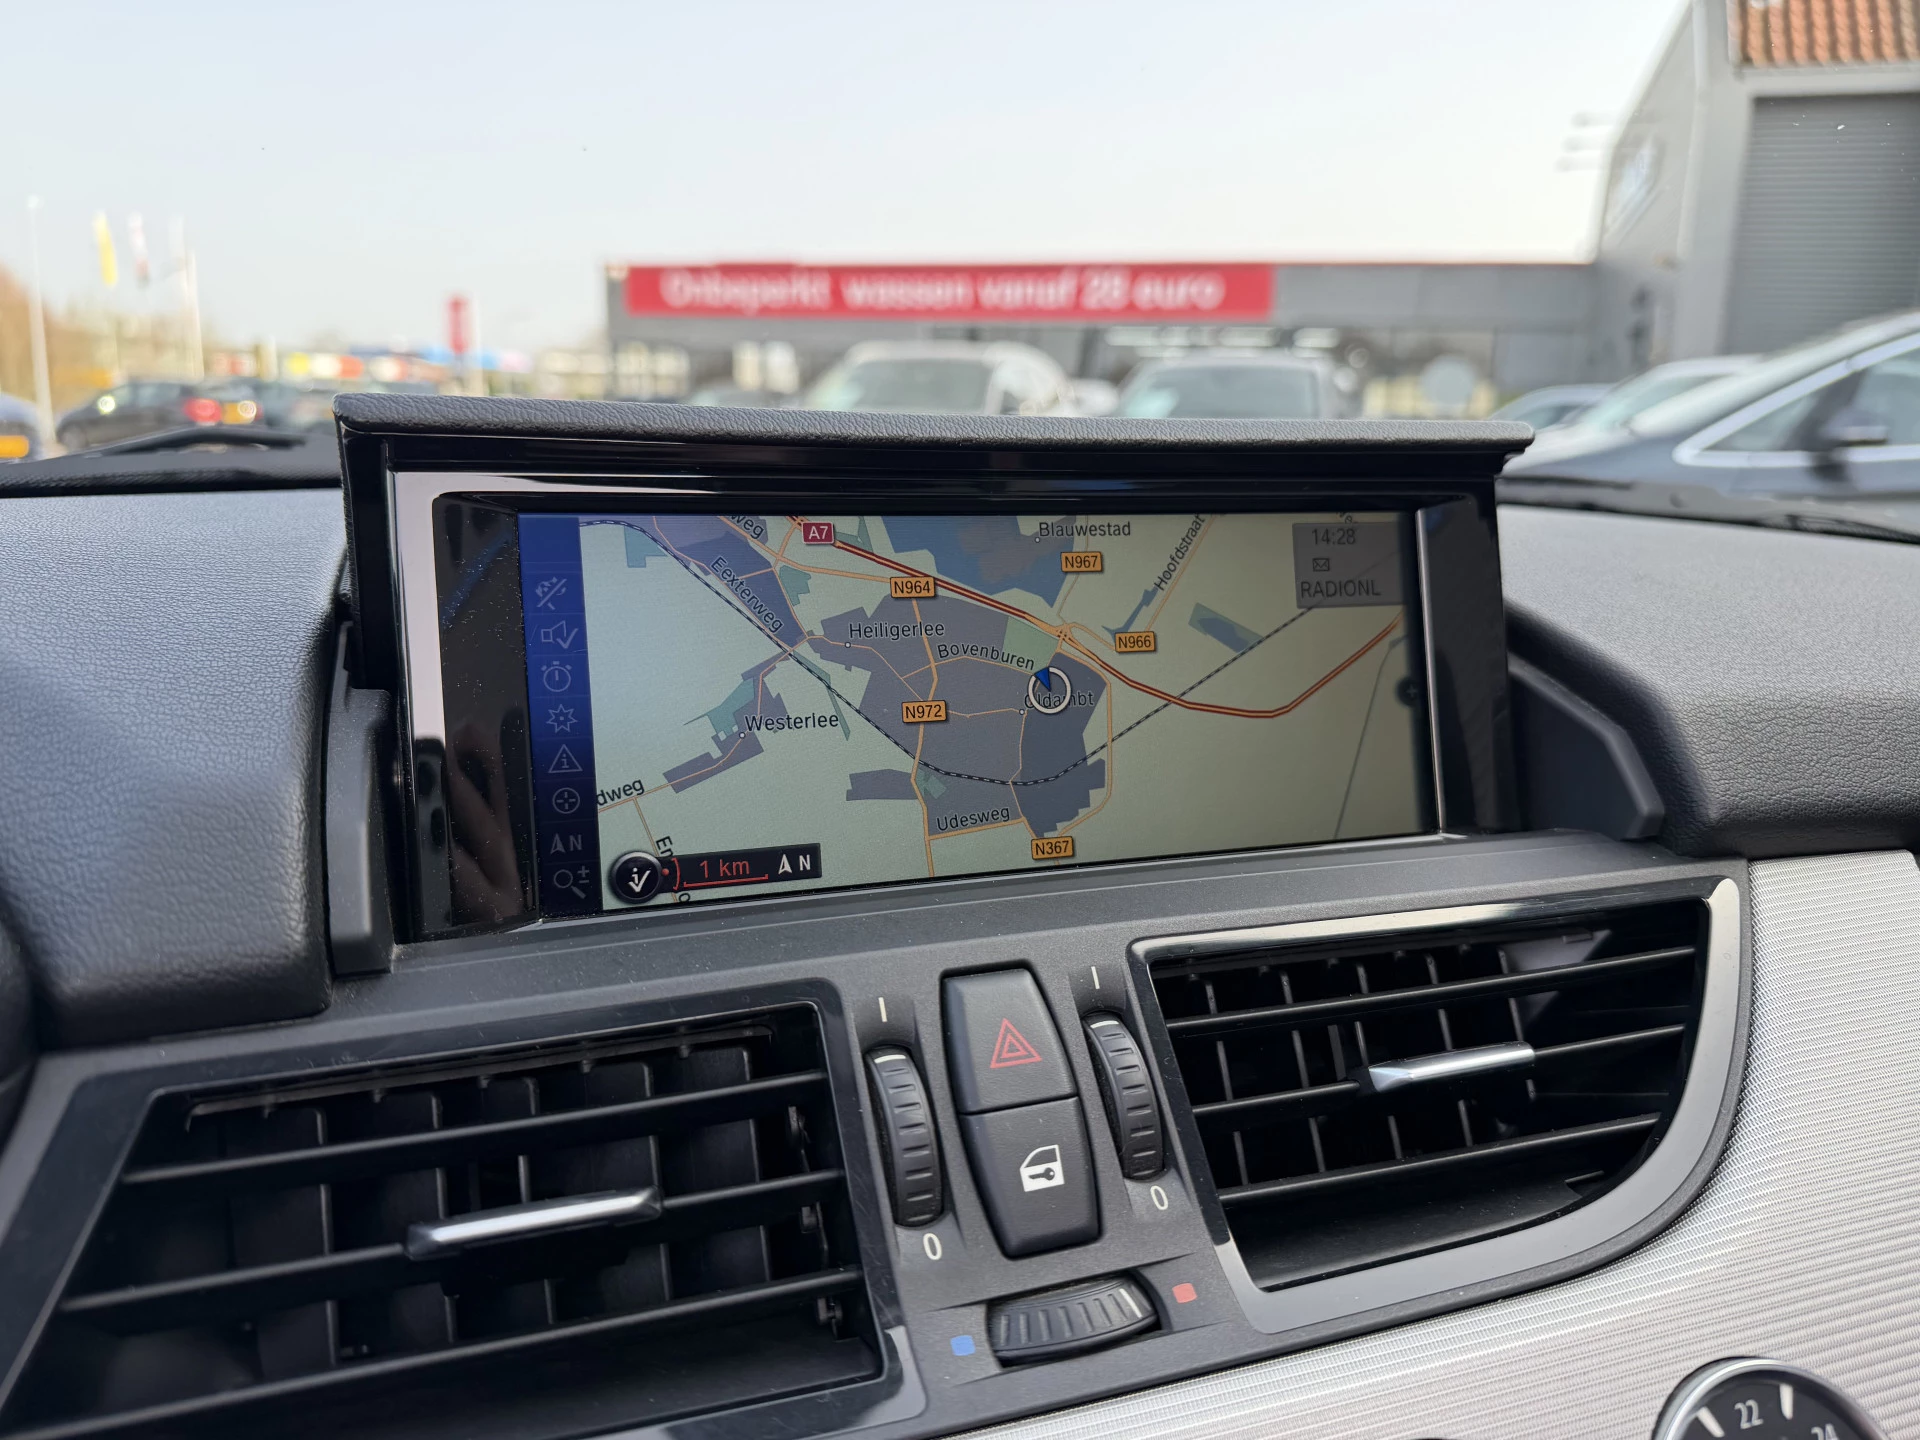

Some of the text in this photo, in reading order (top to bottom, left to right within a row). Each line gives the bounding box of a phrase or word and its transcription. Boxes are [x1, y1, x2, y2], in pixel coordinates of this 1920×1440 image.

[808, 525, 829, 540] A7
[1038, 521, 1131, 537] Blauwestad
[1312, 528, 1356, 546] 14:28
[1154, 513, 1205, 591] Hoofdstraat
[1064, 555, 1098, 569] N967
[710, 557, 785, 633] Eexterweg
[893, 580, 931, 595] N964
[1301, 579, 1382, 599] RADIONL
[849, 622, 945, 640] Heiligerlee
[1118, 635, 1151, 649] N966
[937, 642, 1035, 671] Bovenburen
[905, 704, 943, 719] N972
[745, 712, 839, 732] Westerlee
[936, 807, 1011, 832] Udesweg
[1035, 841, 1070, 855] N367
[700, 858, 750, 878] 1 km
[1734, 1399, 1764, 1430] 22
